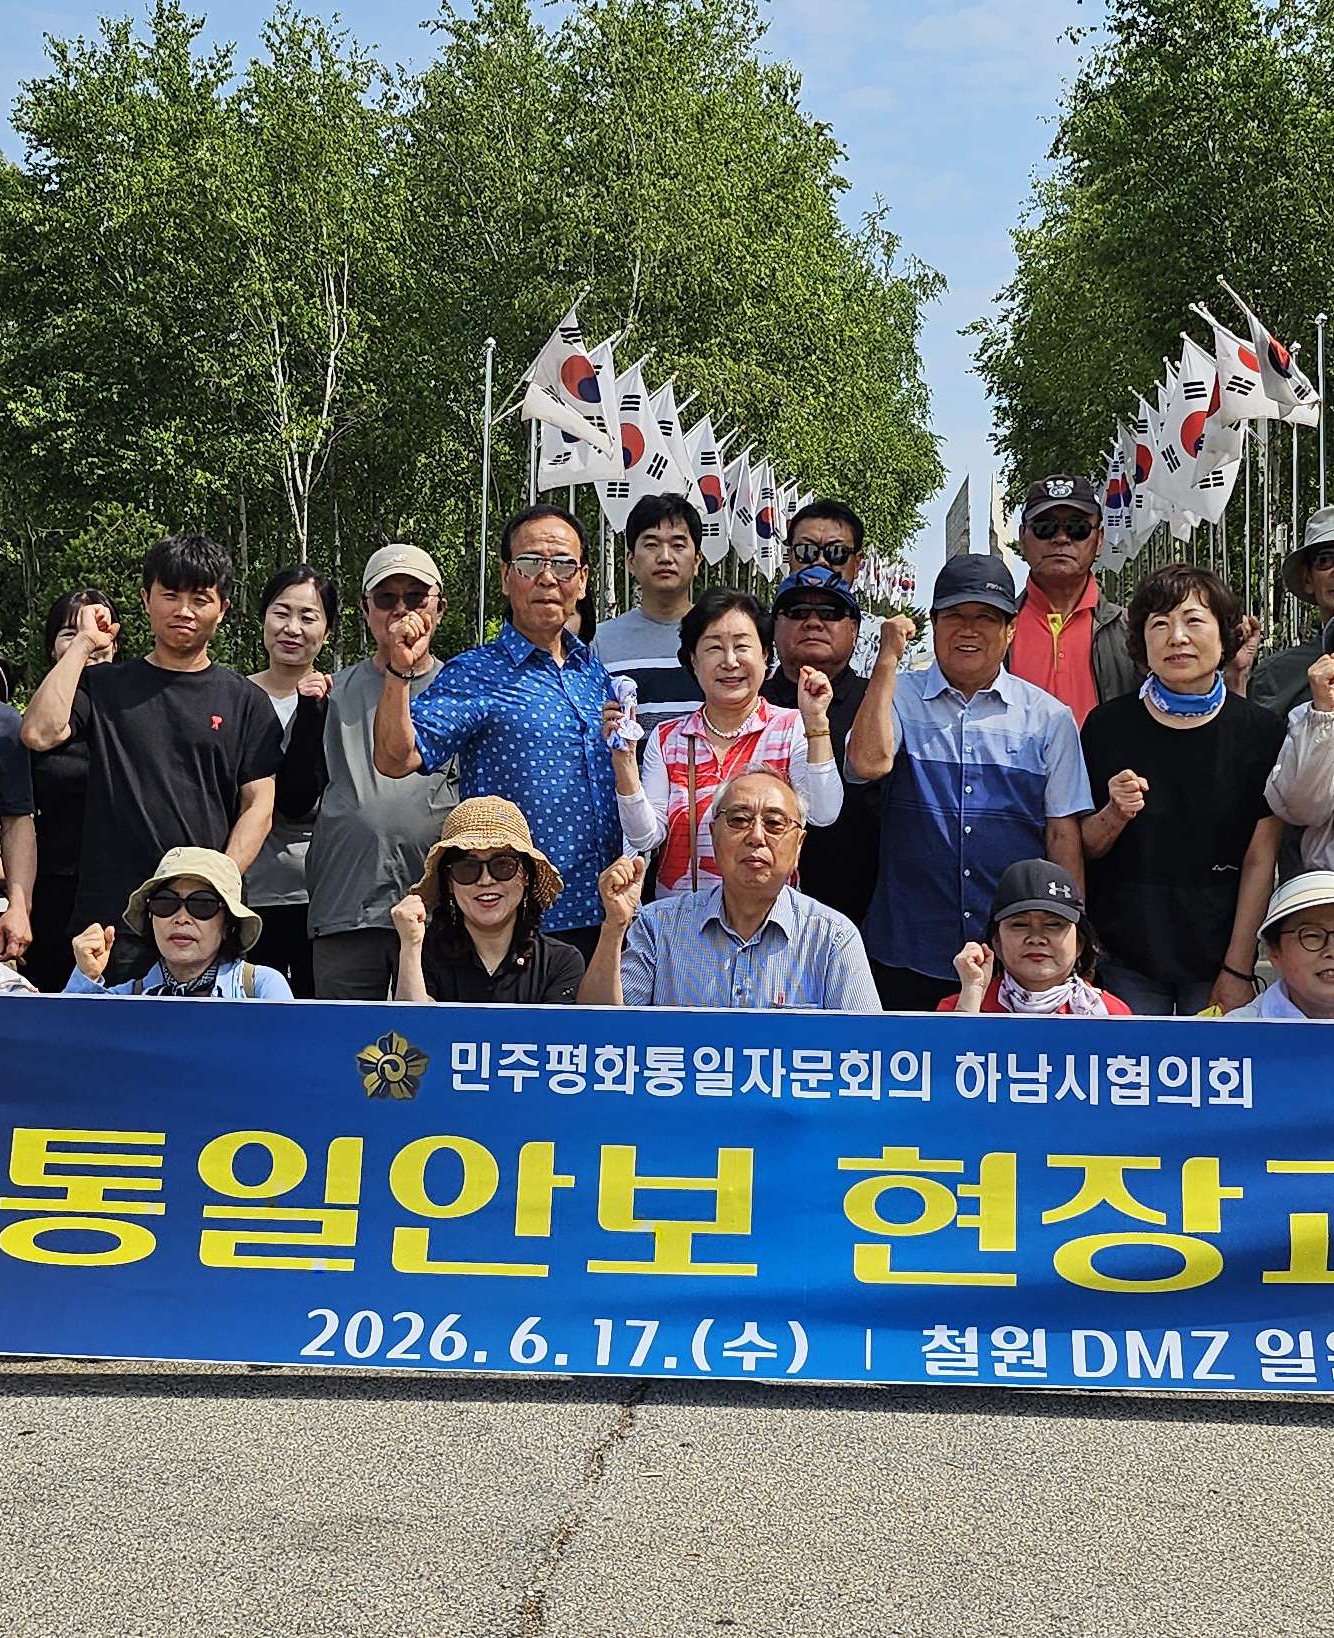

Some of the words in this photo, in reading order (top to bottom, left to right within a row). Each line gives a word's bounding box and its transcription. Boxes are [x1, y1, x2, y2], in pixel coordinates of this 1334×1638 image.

[450, 1041, 932, 1102] 민주평화통일자문회의
[954, 1052, 1255, 1109] 하남시협의회
[300, 1308, 488, 1364] 2026.
[508, 1317, 569, 1367] 6.
[592, 1318, 810, 1374] 17.(수)
[920, 1323, 1049, 1382] 철원
[1070, 1329, 1237, 1381] DMZ
